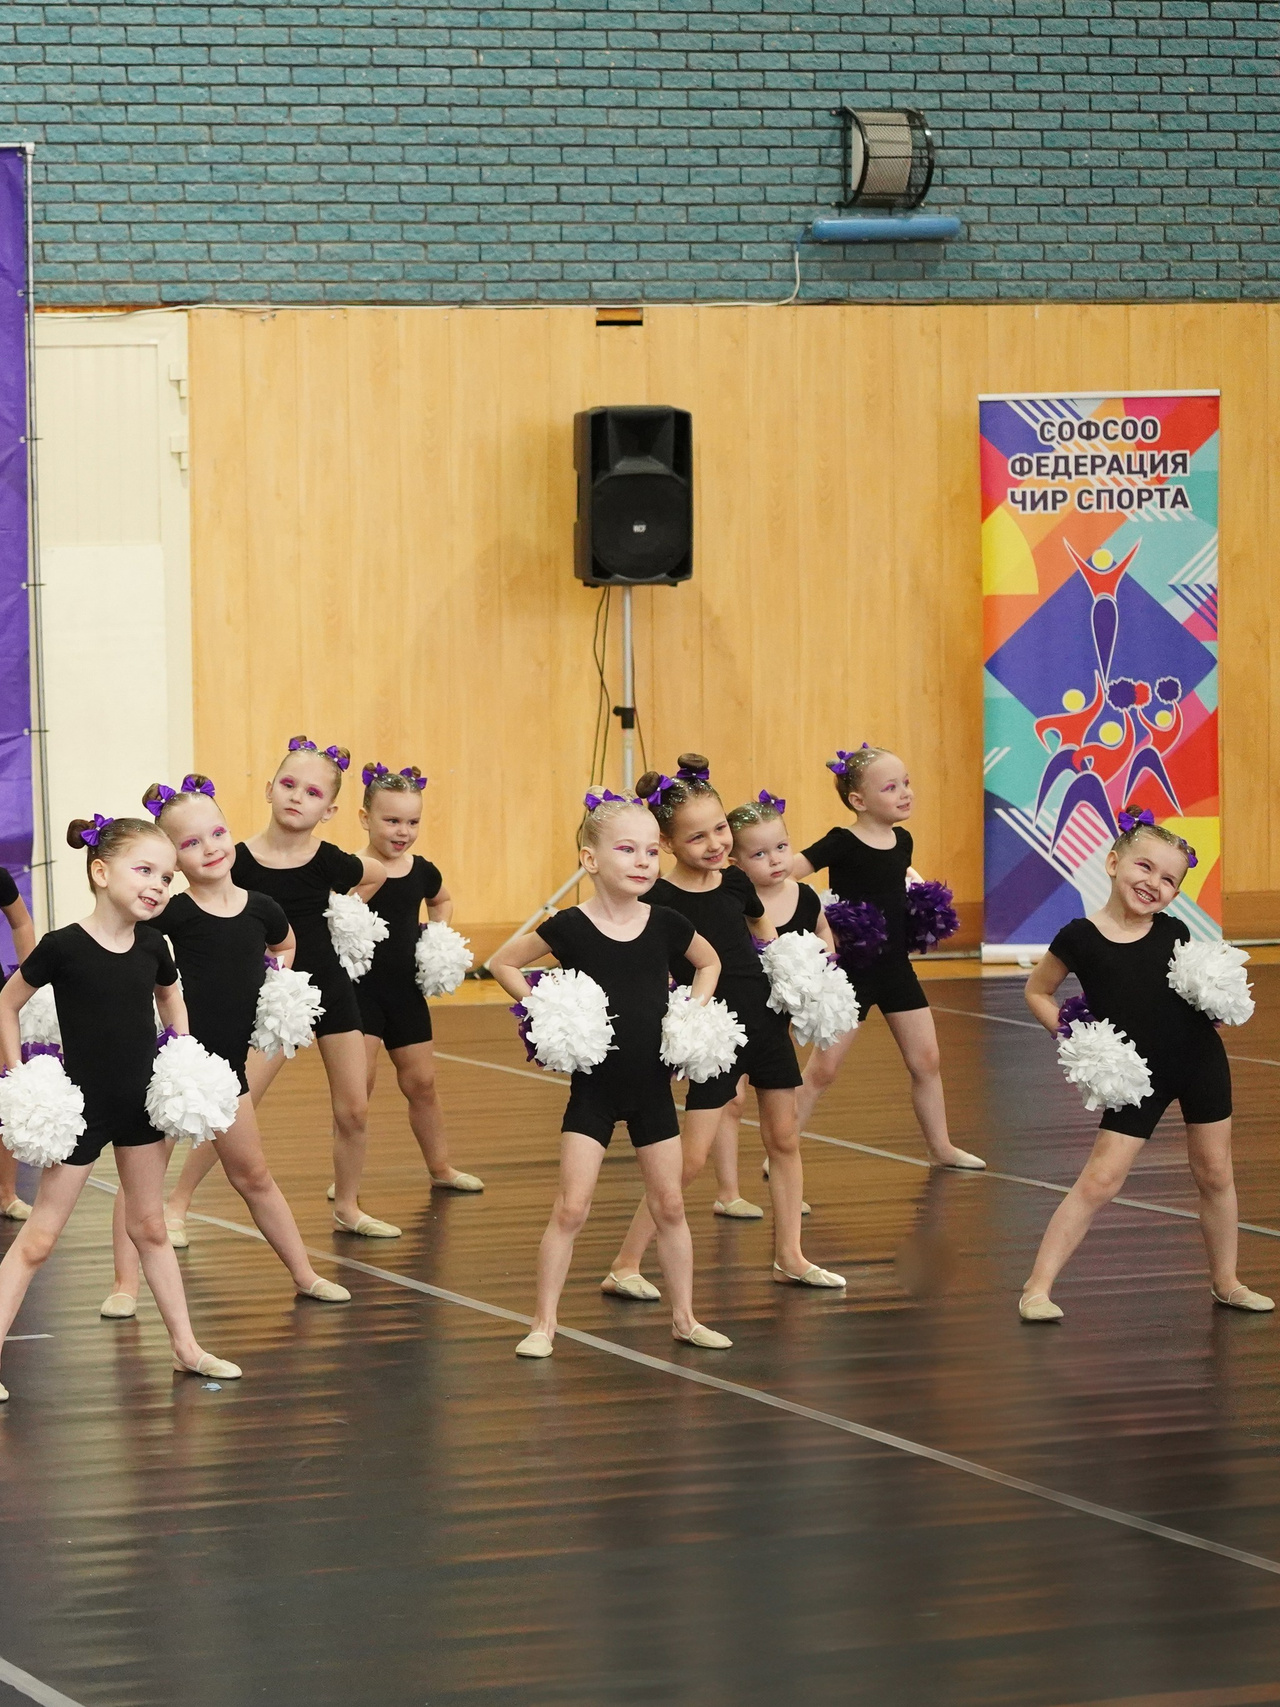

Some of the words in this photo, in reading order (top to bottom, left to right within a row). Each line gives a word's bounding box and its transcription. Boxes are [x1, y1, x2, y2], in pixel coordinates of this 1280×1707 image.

[1039, 418, 1159, 442] СОФСОО
[1010, 452, 1188, 480] ФЕДЕРАЦИЯ
[1010, 490, 1068, 511] ЧИР
[1077, 487, 1189, 511] СПОРТА
